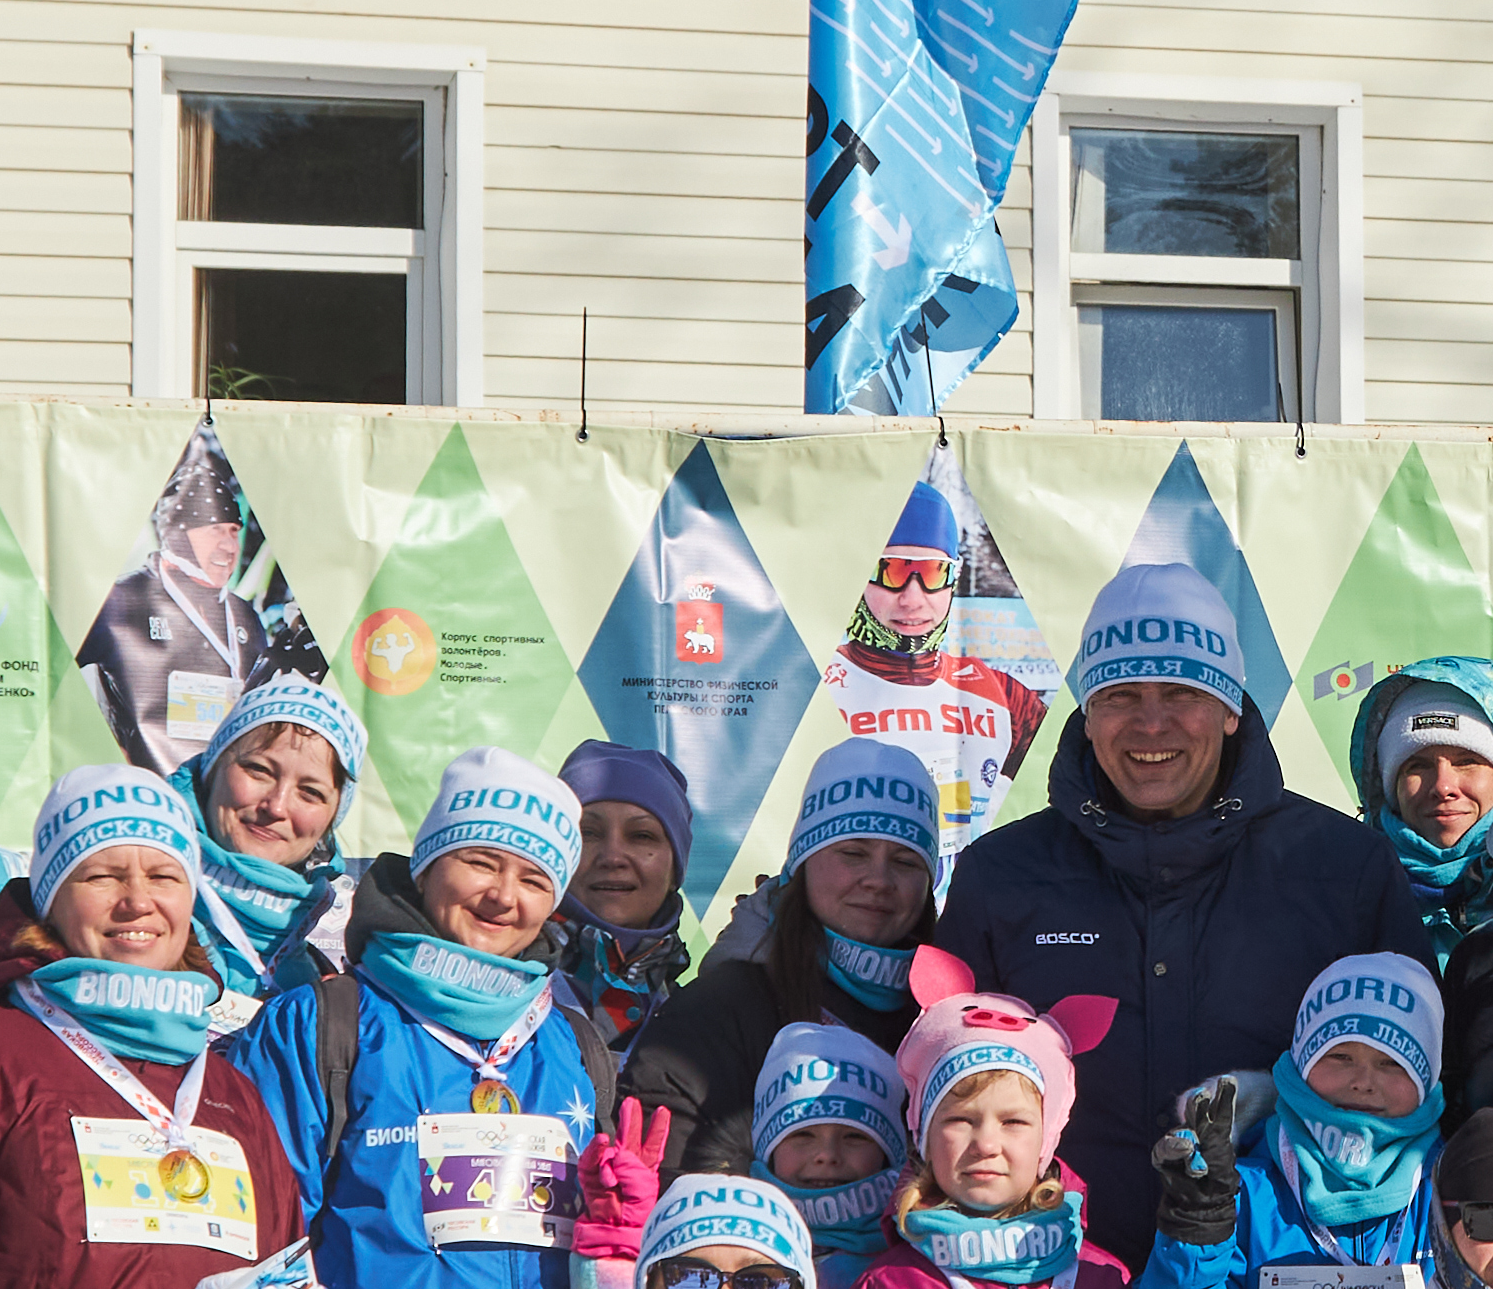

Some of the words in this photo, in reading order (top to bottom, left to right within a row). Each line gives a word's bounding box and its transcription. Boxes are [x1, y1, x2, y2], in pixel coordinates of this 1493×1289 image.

[441, 632, 477, 645] Корпус
[1078, 618, 1227, 669] IONORD
[1, 660, 40, 672] ФОНД
[621, 677, 704, 689] МИНИСТЕРСТВО
[706, 678, 778, 691] ФИЗИЧЕСКОЙ
[647, 691, 698, 703] КУЛЬТУРЫ
[701, 693, 708, 703] И
[711, 694, 754, 704] СПОРТА
[720, 707, 748, 717] КРАЯ
[940, 703, 997, 739] Ski
[1035, 932, 1100, 946] BOSCO
[74, 971, 206, 1018] BIONORD
[365, 1125, 417, 1148] БИОН
[930, 1222, 1064, 1268] BIONORD
